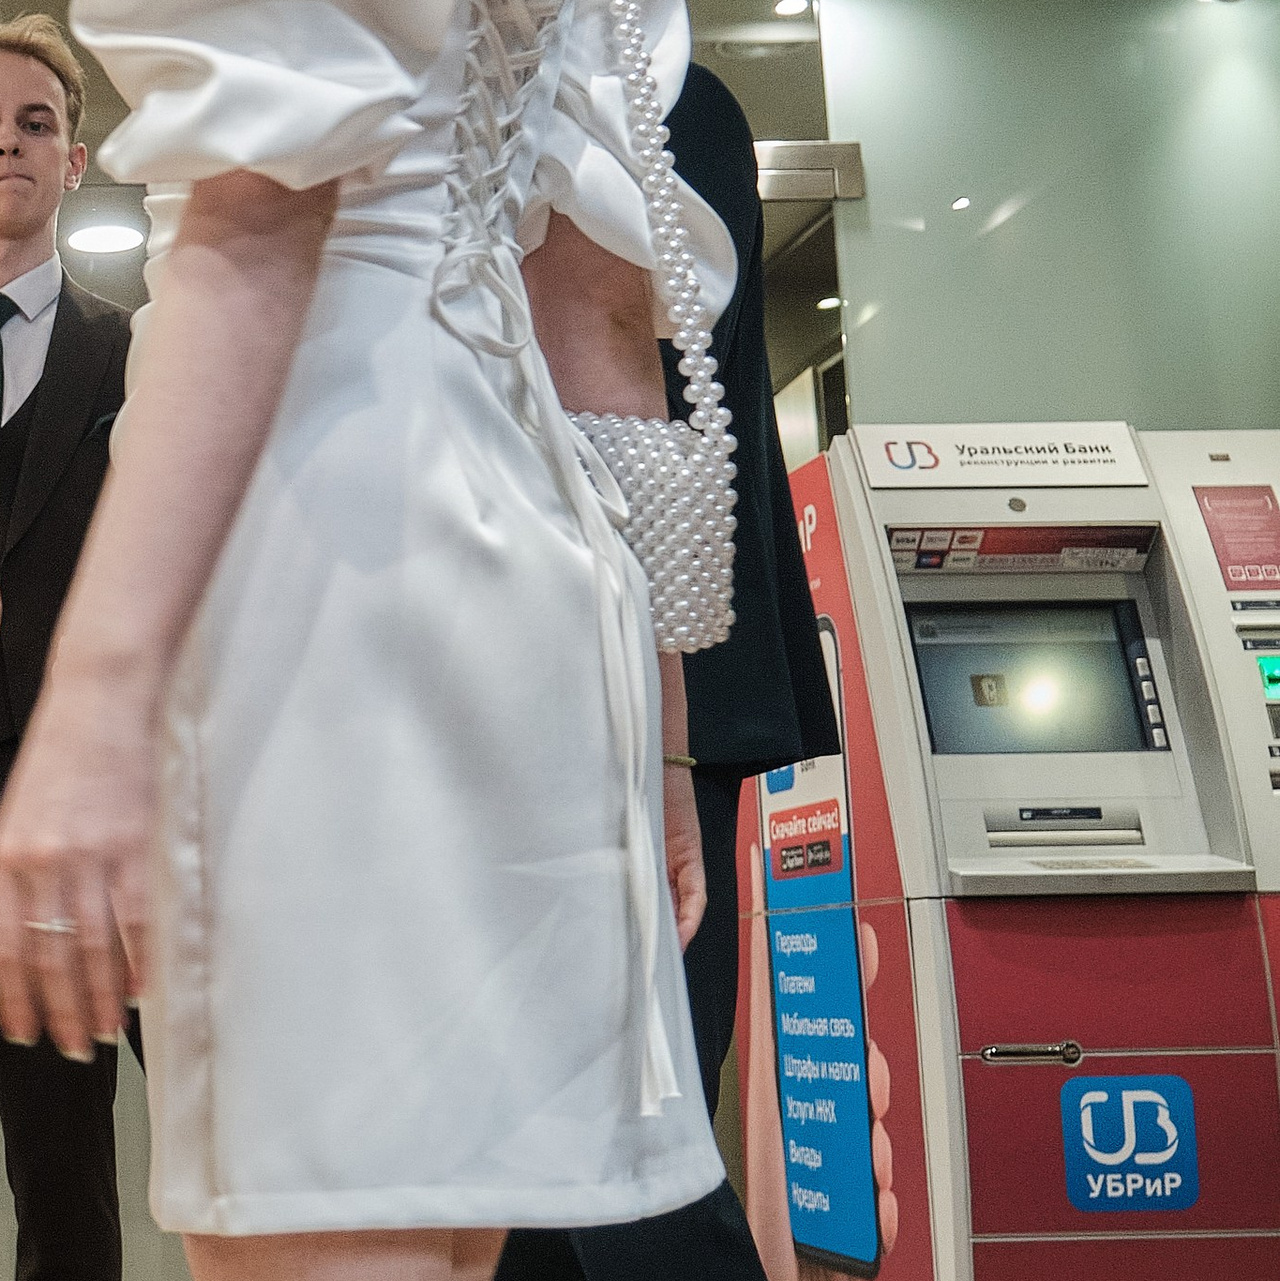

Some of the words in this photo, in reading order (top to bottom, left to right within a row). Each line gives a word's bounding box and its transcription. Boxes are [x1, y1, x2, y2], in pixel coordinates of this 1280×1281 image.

[955, 442, 1059, 457] Уральский
[1063, 442, 1112, 454] Банк
[770, 815, 807, 840] Скачайте
[807, 807, 839, 835] сейчас!
[775, 930, 818, 957] Переводы
[778, 971, 816, 994] Платежи
[781, 1012, 829, 1036] Мобильная
[829, 1017, 855, 1038] связь
[783, 1053, 820, 1083] Штрафы
[820, 1062, 827, 1079] и
[827, 1062, 860, 1082] налоги
[786, 1094, 815, 1125] Услуги
[815, 1098, 837, 1123] ЖКХ
[789, 1139, 822, 1171] Вклады
[792, 1182, 830, 1213] Кредиты
[1086, 1172, 1182, 1198] УБРиР
